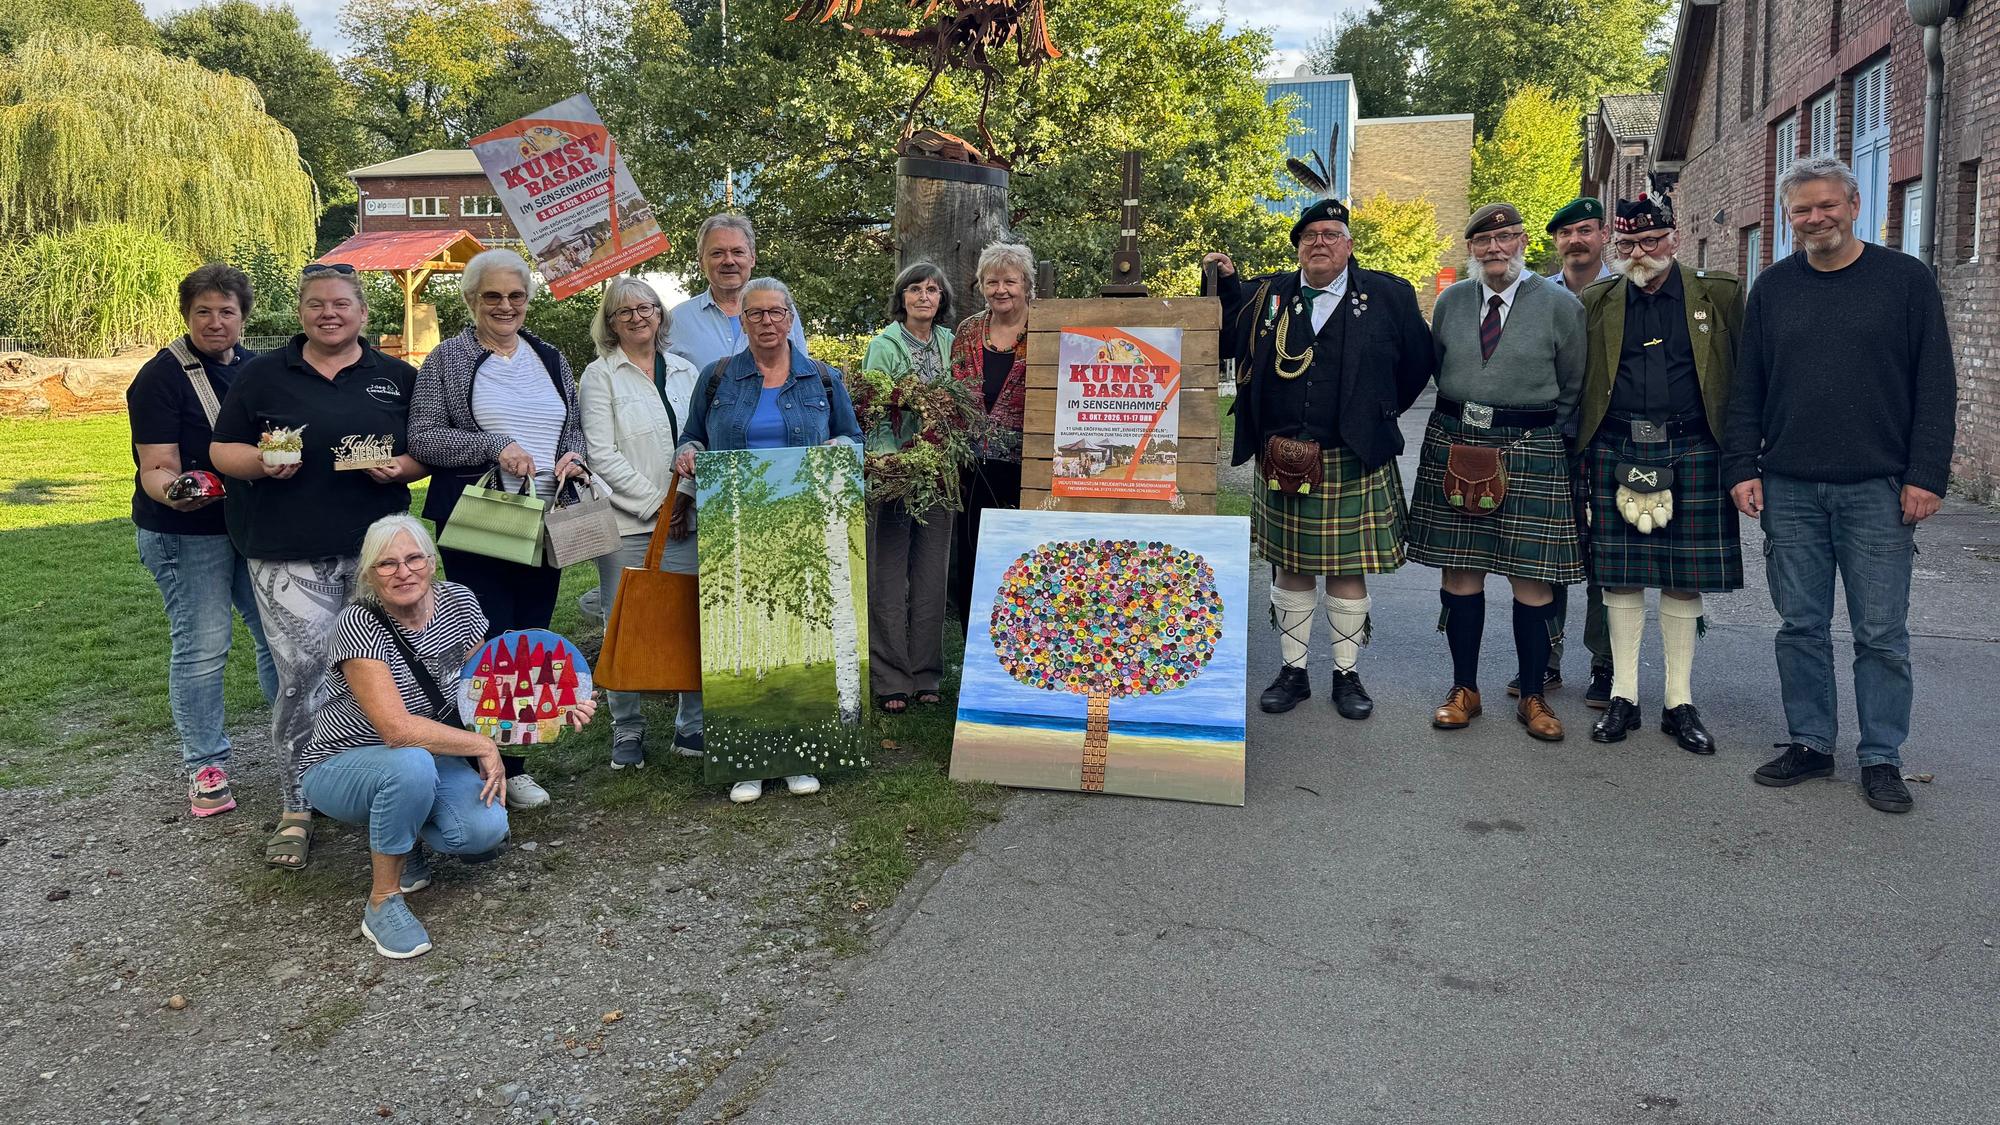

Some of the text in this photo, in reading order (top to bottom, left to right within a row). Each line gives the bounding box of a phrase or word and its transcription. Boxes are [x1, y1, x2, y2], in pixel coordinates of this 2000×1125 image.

[500, 132, 600, 190] KUNST
[524, 157, 598, 197] BASAR
[520, 166, 617, 215] IM SENSENHAMMER
[377, 202, 386, 210] alp
[540, 210, 548, 218] 3.
[547, 204, 563, 215] OKT.
[580, 189, 595, 201] 11-17
[594, 183, 609, 194] UHR
[1069, 364, 1170, 383] KUNST
[1082, 384, 1154, 398] BASAR
[1068, 400, 1168, 410] IM SENSENHAMMER
[341, 434, 382, 450] Hallo
[351, 446, 392, 460] HERBST
